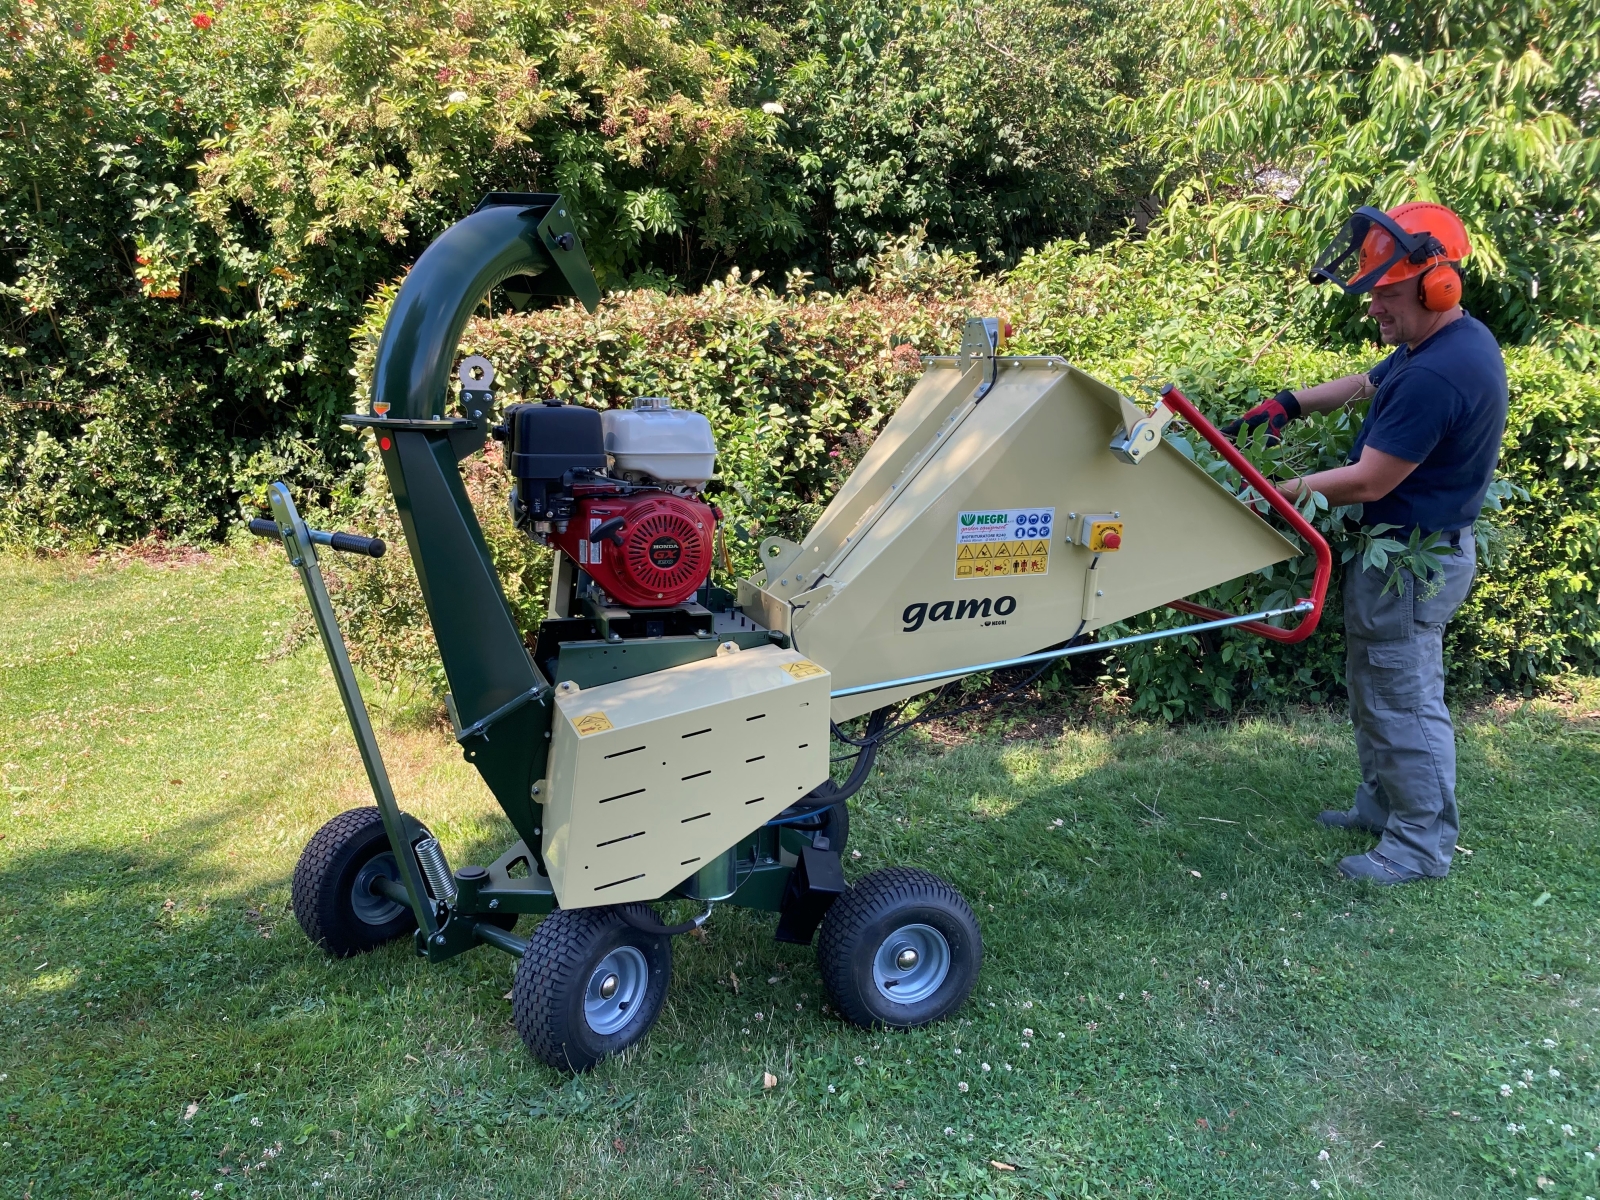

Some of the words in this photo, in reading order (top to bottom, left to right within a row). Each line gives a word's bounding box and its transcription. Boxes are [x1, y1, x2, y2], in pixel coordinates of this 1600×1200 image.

[977, 514, 1008, 525] NEGRI
[960, 524, 979, 533] garden
[980, 523, 1009, 533] equipment
[653, 550, 678, 559] GX
[902, 596, 1017, 633] gamo
